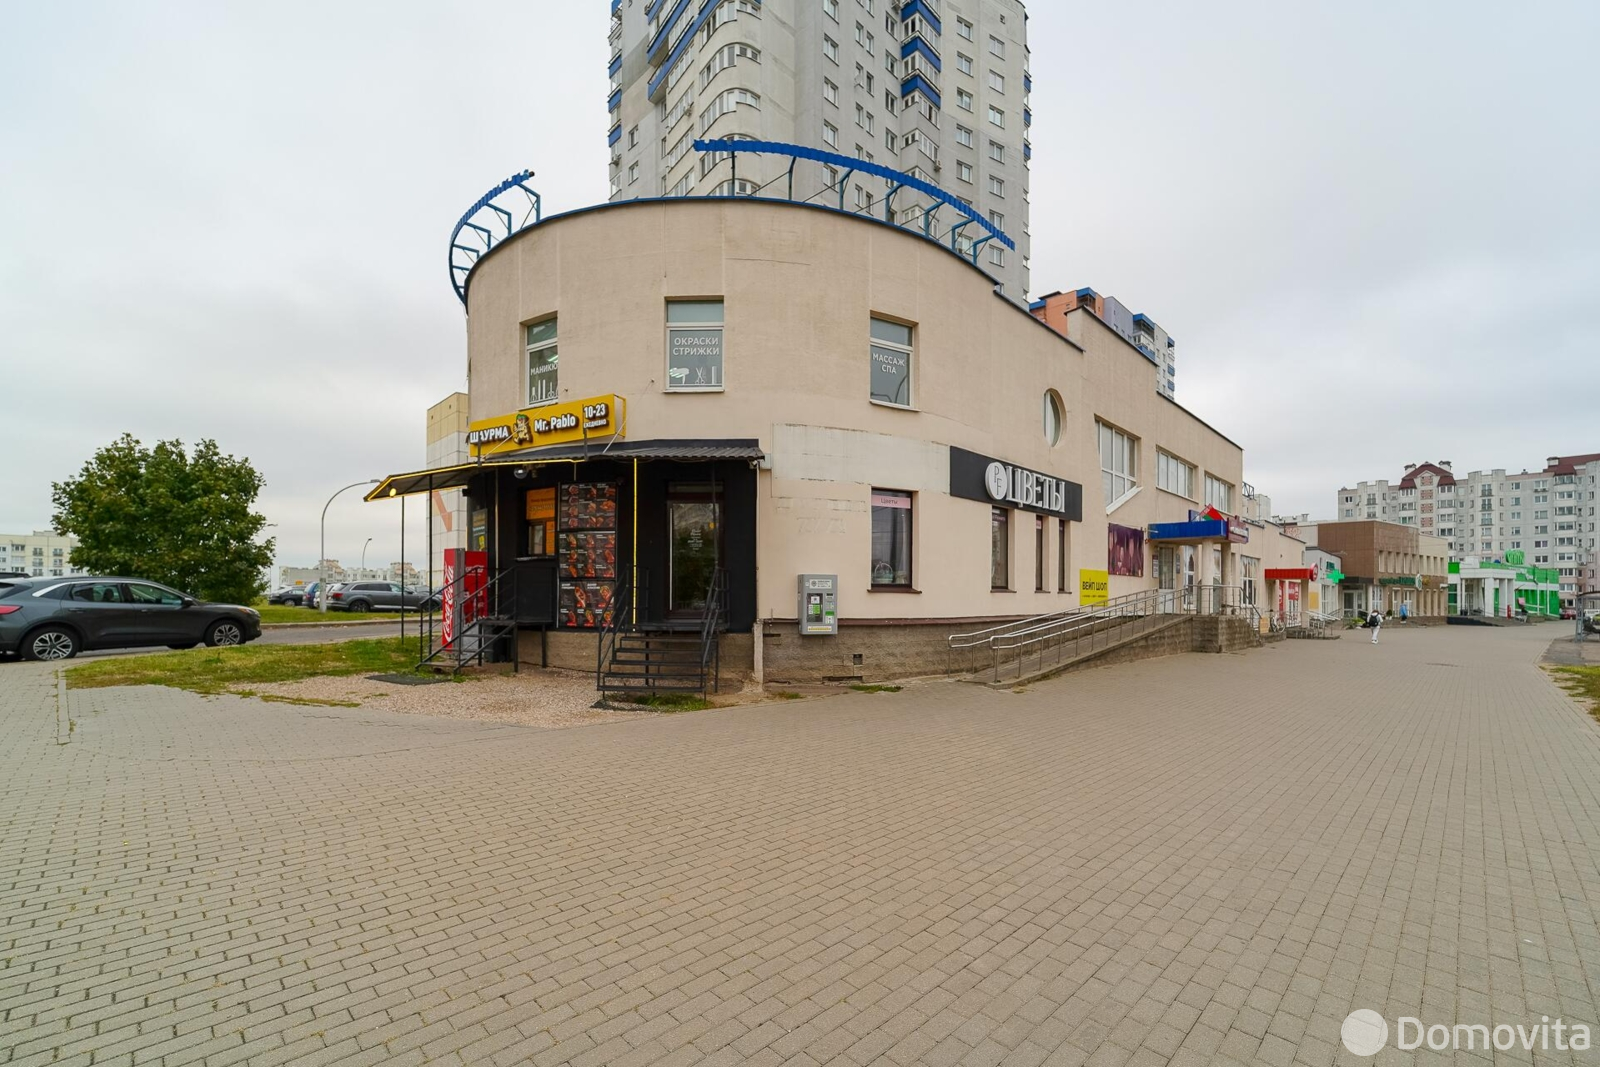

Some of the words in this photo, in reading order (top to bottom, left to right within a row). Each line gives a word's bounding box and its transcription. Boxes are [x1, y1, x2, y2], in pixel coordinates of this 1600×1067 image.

[674, 337, 719, 346] ОКРАСКИ
[672, 347, 720, 356] СТРИЖКИ
[872, 352, 905, 367] МАССАЖ
[881, 364, 897, 375] СПА
[583, 403, 606, 419] 10-23
[534, 419, 549, 432] Mr.
[551, 415, 576, 430] Pablo
[1005, 465, 1066, 513] ЦВЕТЫ
